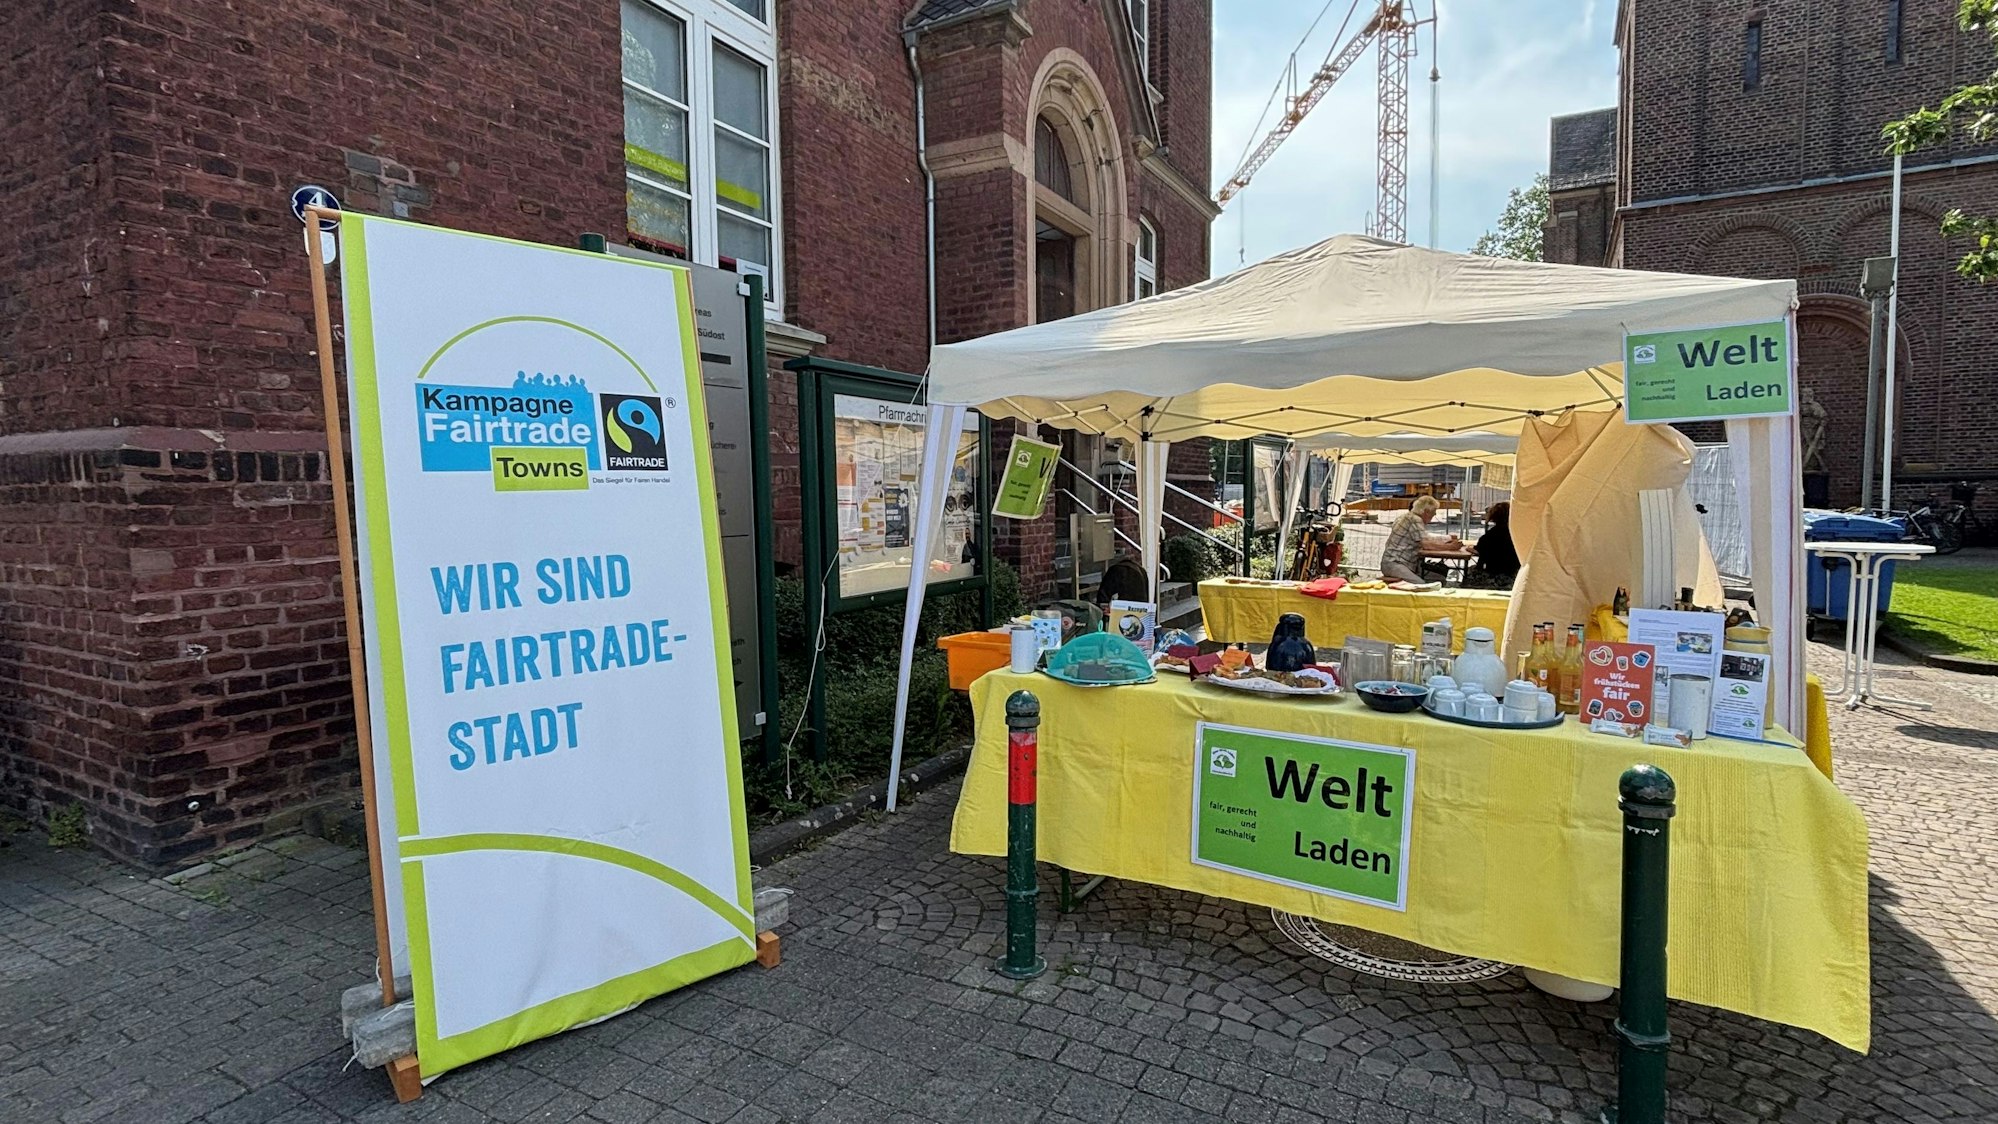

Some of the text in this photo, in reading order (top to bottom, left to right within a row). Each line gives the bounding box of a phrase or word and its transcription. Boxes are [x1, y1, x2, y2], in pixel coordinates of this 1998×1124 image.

[697, 327, 725, 340] Südost
[1677, 335, 1779, 369] Welt
[1706, 381, 1782, 401] Laden
[423, 387, 574, 418] Kampagne
[424, 412, 592, 445] Fairtrade
[496, 456, 584, 479] Towns
[609, 456, 666, 468] FAIRTRADE
[605, 477, 624, 485] Siegel
[430, 554, 631, 615] WIR SIND
[440, 618, 687, 694] FAIRTRADE-
[1593, 677, 1641, 690] frühstücken
[1609, 672, 1626, 681] Wir
[1602, 686, 1631, 701] fair
[447, 702, 583, 771] STADT
[1264, 756, 1393, 818] Welt
[1209, 800, 1257, 818] fair, gerecht
[1240, 820, 1257, 829] und
[1215, 827, 1257, 843] nachhaltig
[1294, 831, 1391, 875] Laden
